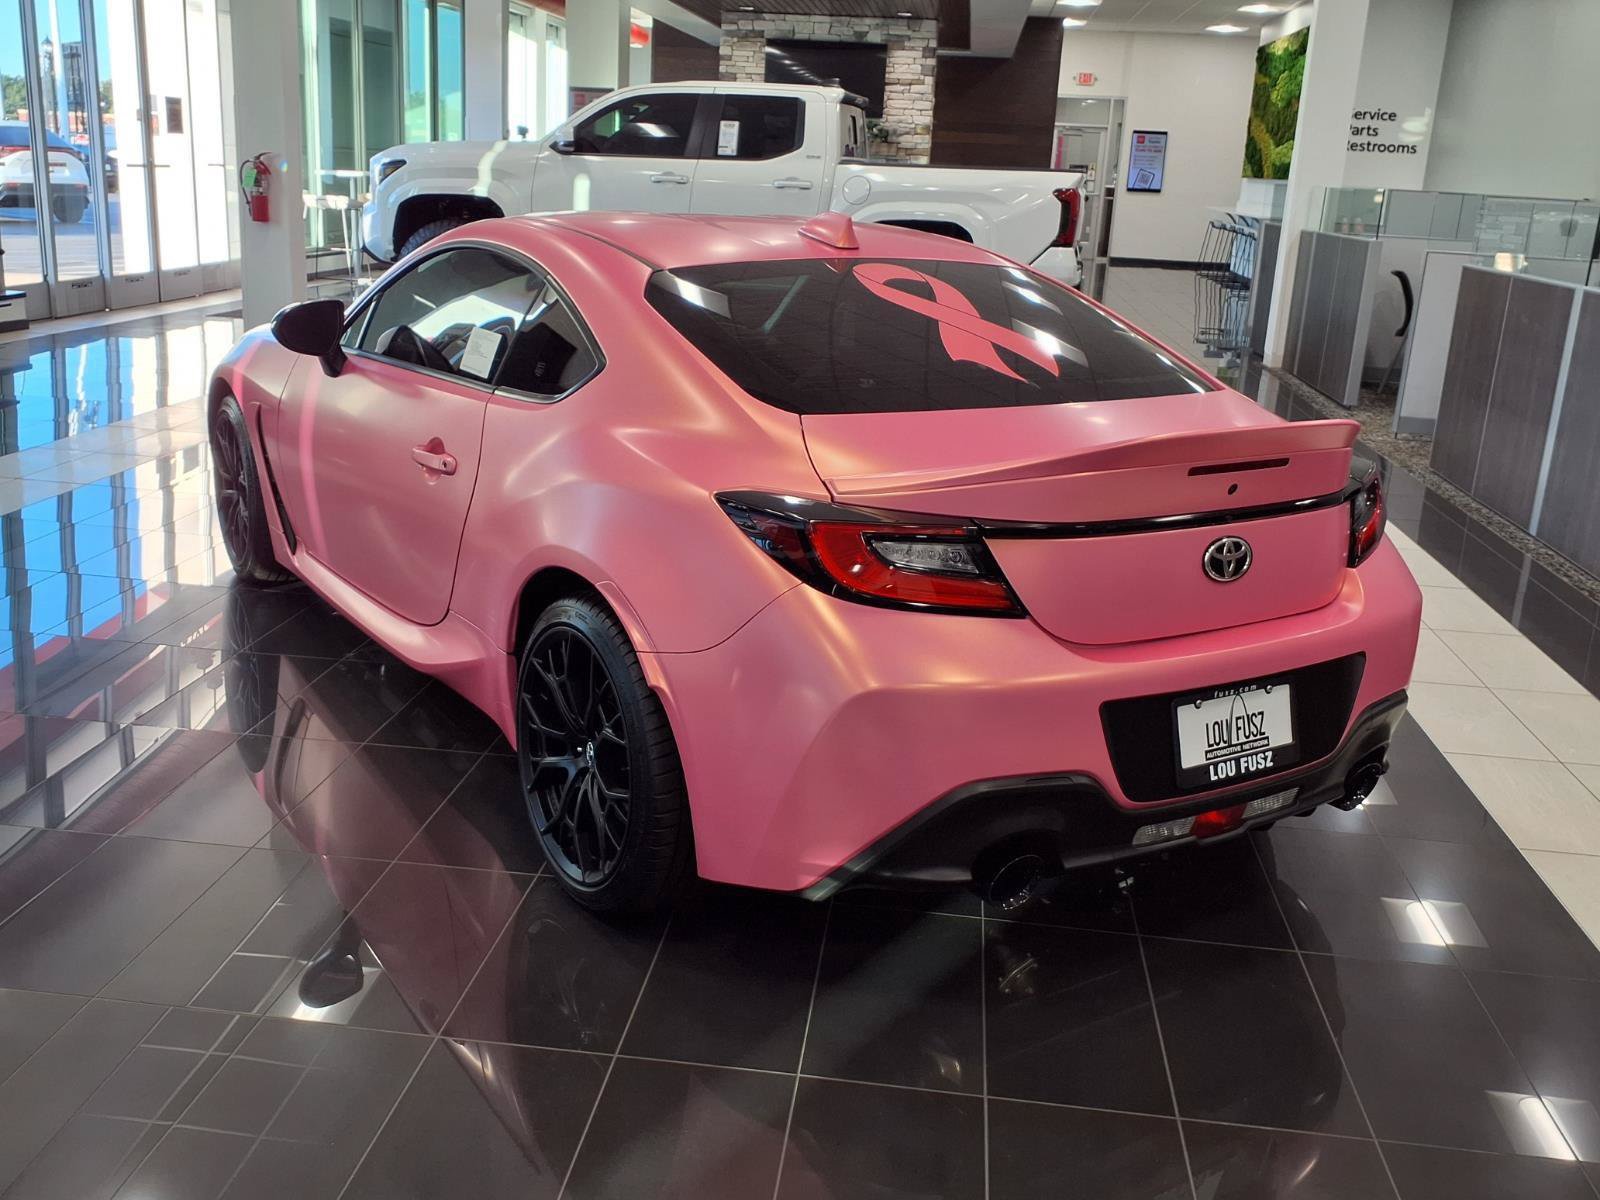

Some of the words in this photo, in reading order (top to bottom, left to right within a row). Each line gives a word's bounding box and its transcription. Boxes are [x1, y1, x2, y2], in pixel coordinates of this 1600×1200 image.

[1351, 108, 1397, 121] ervice
[1349, 124, 1379, 137] arts
[1214, 685, 1257, 698] fusz.com
[1205, 718, 1229, 748] LOU
[1235, 710, 1266, 741] FUSZ
[1206, 745, 1242, 758] AUTOMOTIVE
[1242, 740, 1269, 750] NETWORK
[1209, 760, 1236, 780] LOU
[1240, 750, 1274, 773] FUSZ
